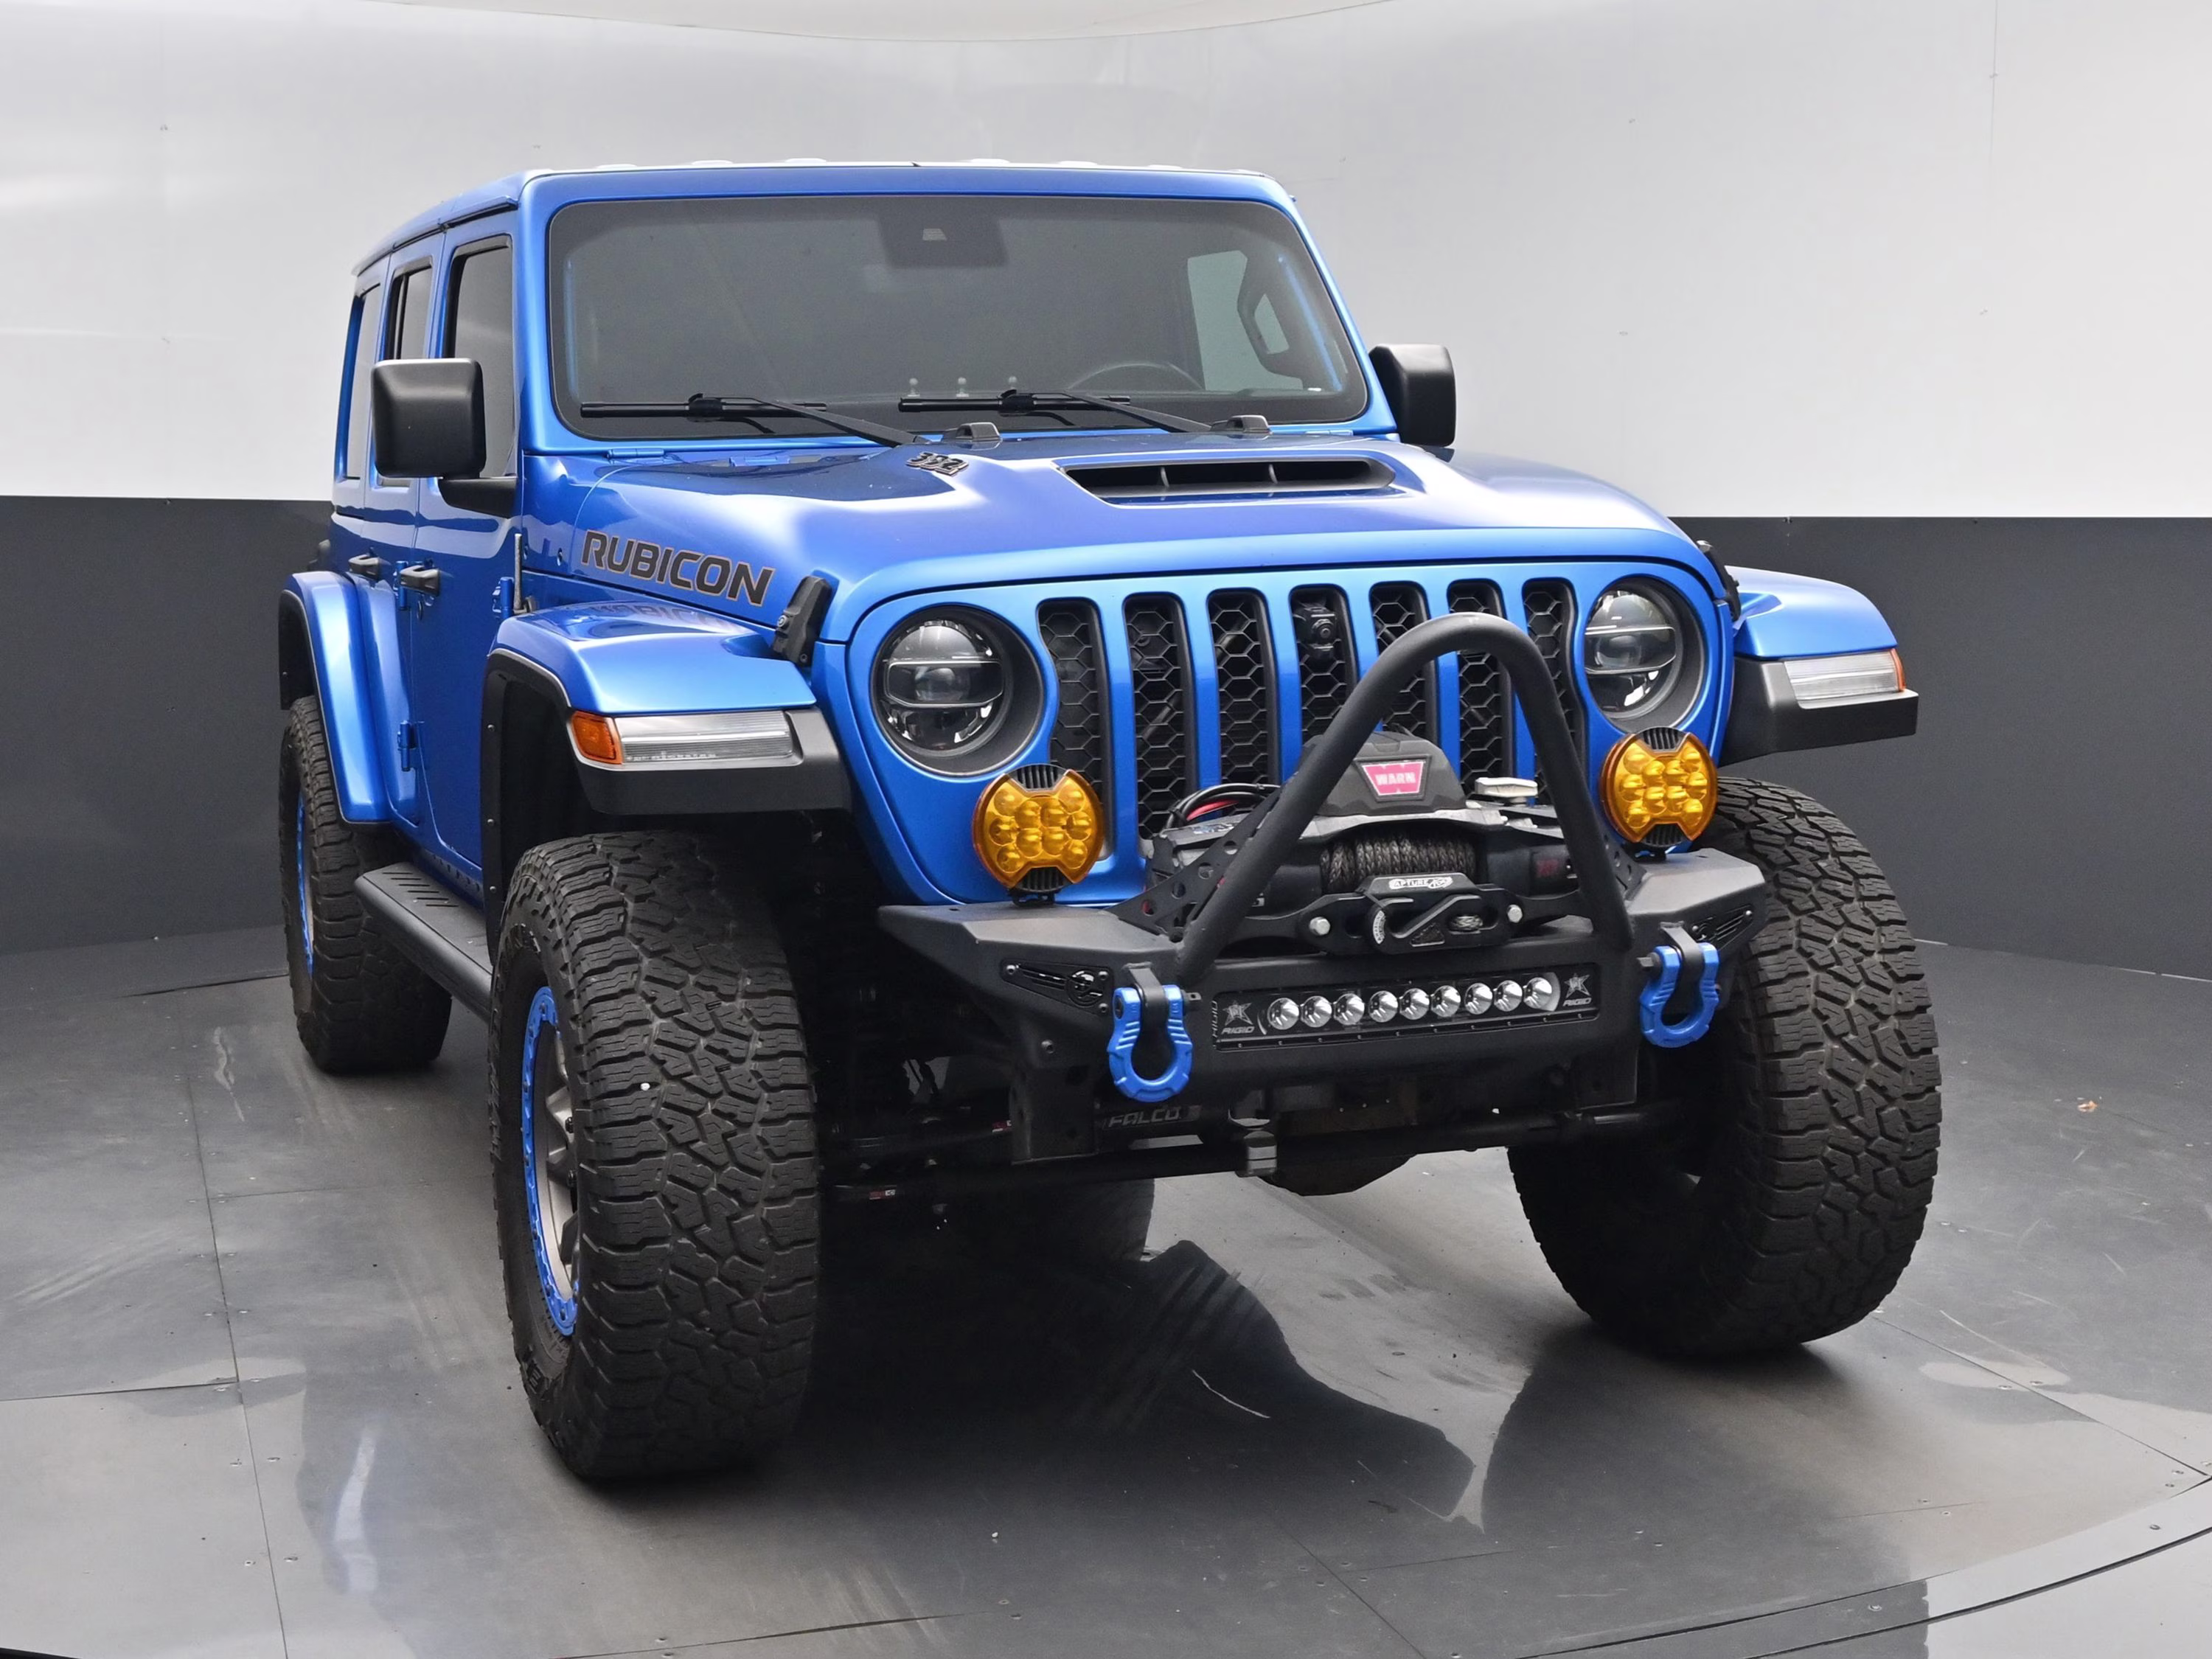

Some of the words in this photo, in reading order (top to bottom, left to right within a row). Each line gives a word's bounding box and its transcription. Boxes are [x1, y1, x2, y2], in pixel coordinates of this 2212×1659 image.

[906, 451, 969, 476] 392
[581, 529, 776, 607] RUBICON
[1374, 772, 1416, 785] WARN
[1562, 997, 1592, 1007] RIGID
[1221, 1026, 1255, 1034] RIGID
